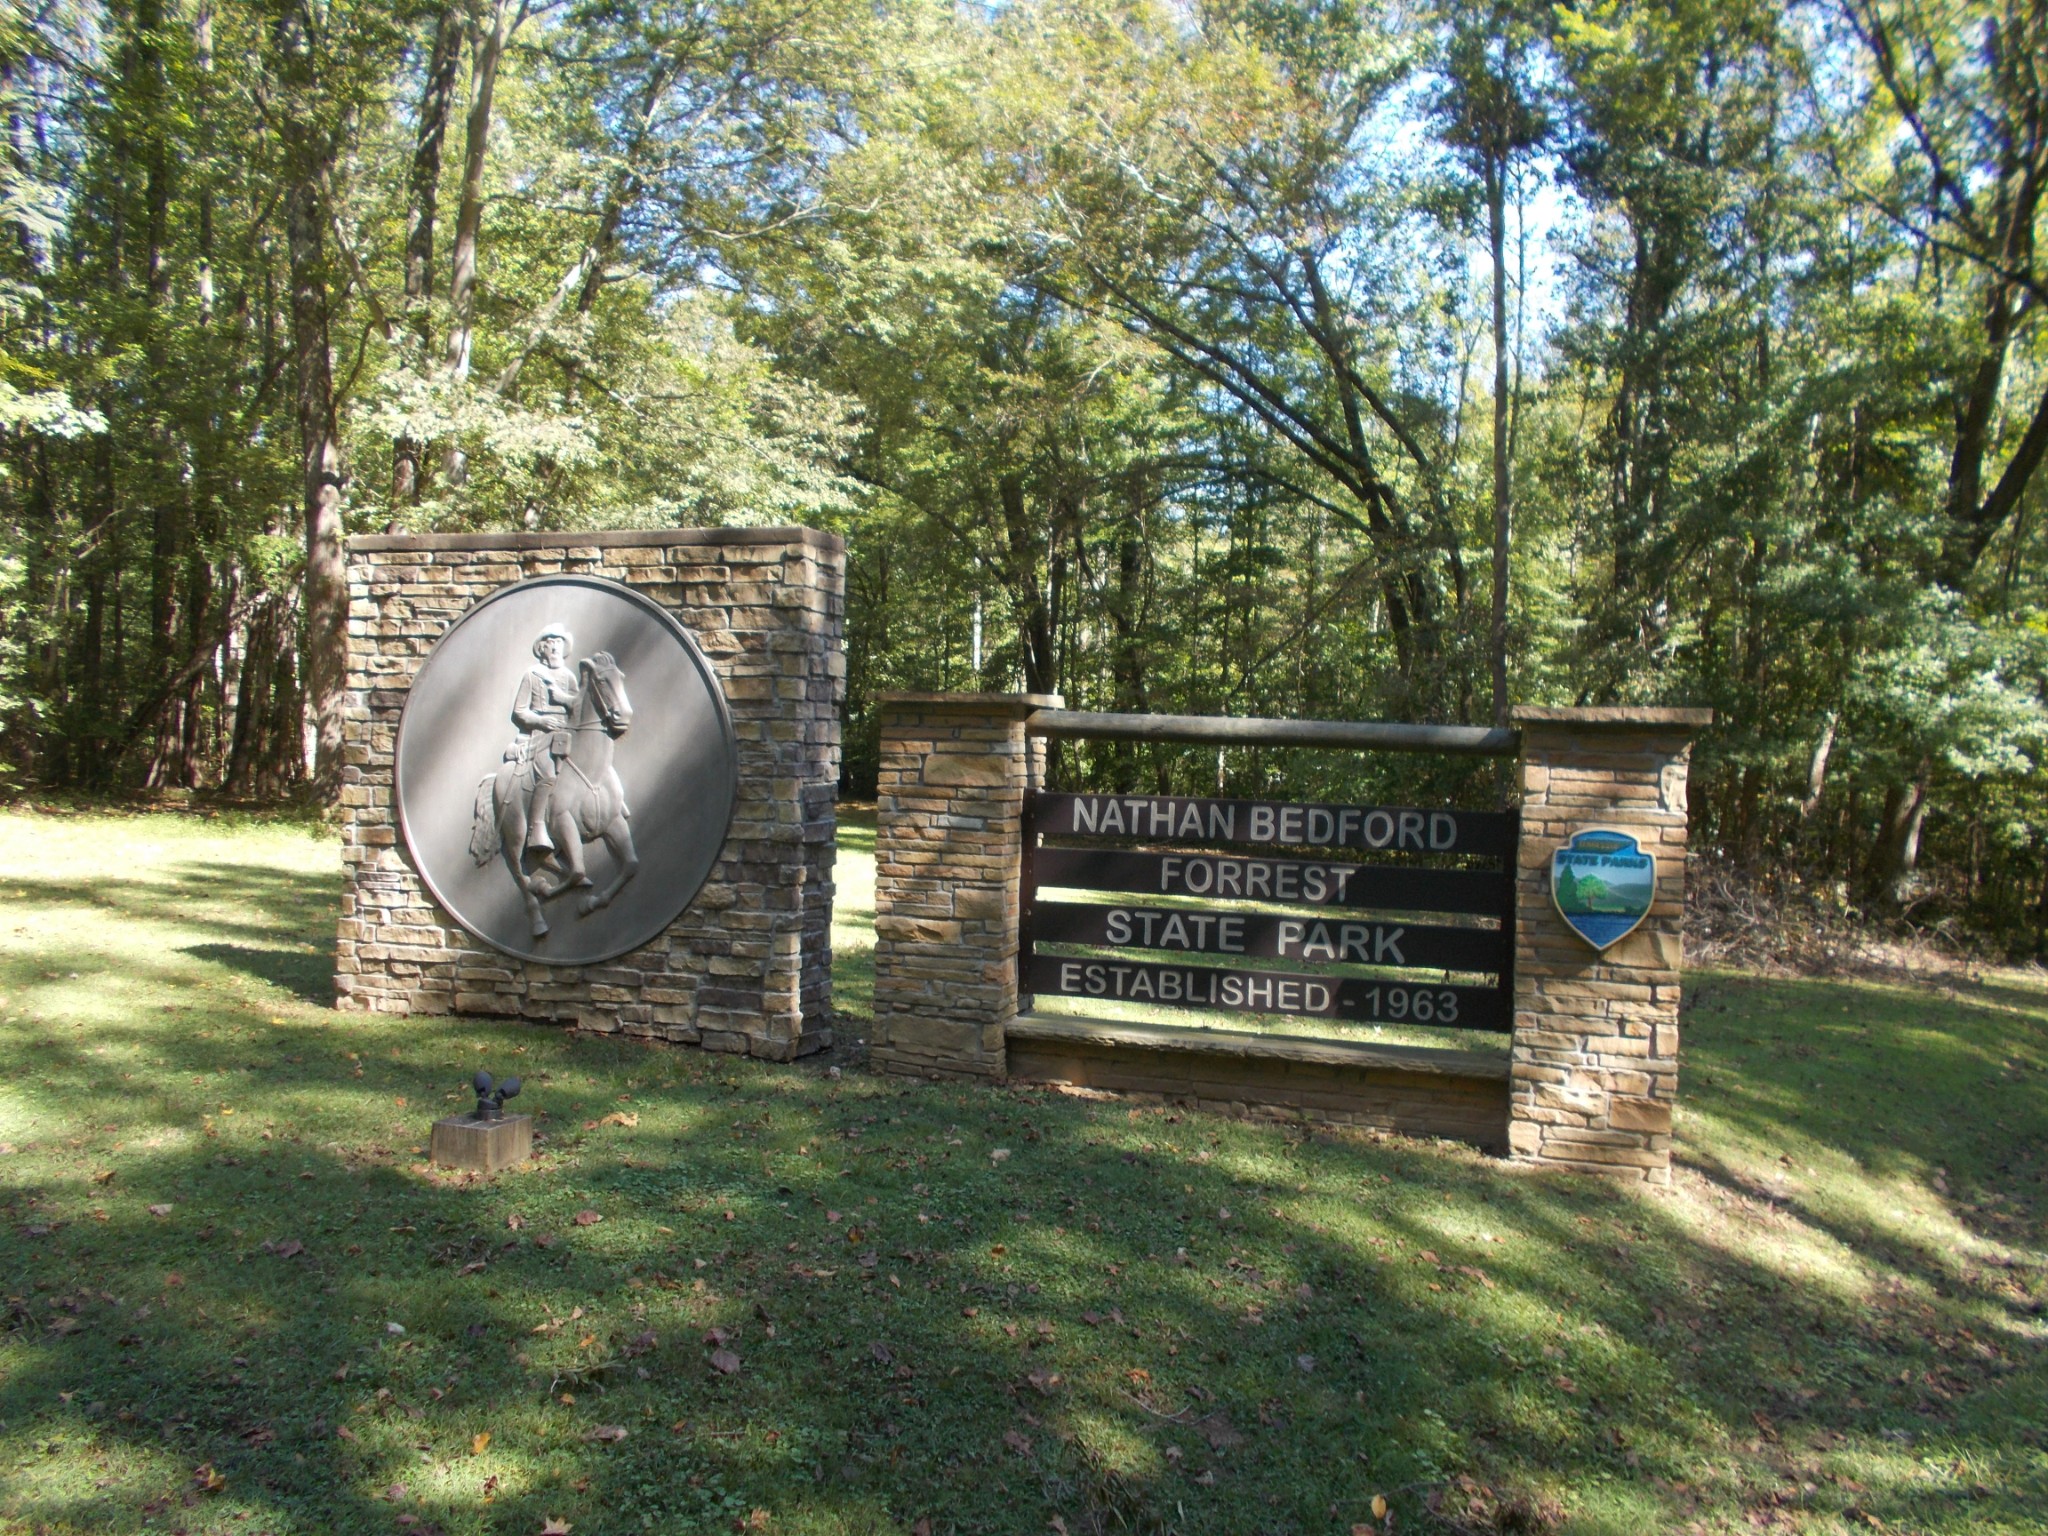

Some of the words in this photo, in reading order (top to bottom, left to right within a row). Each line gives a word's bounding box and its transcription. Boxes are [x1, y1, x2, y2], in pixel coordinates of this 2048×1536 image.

[1073, 798, 1235, 839] NATHAN
[1250, 805, 1458, 850] BEDFORD
[1161, 857, 1356, 902] FORREST
[1106, 910, 1245, 952] STATE
[1278, 921, 1405, 964] PARK
[1061, 963, 1330, 1012] ESTABLISHED
[1365, 987, 1459, 1022] 1963
